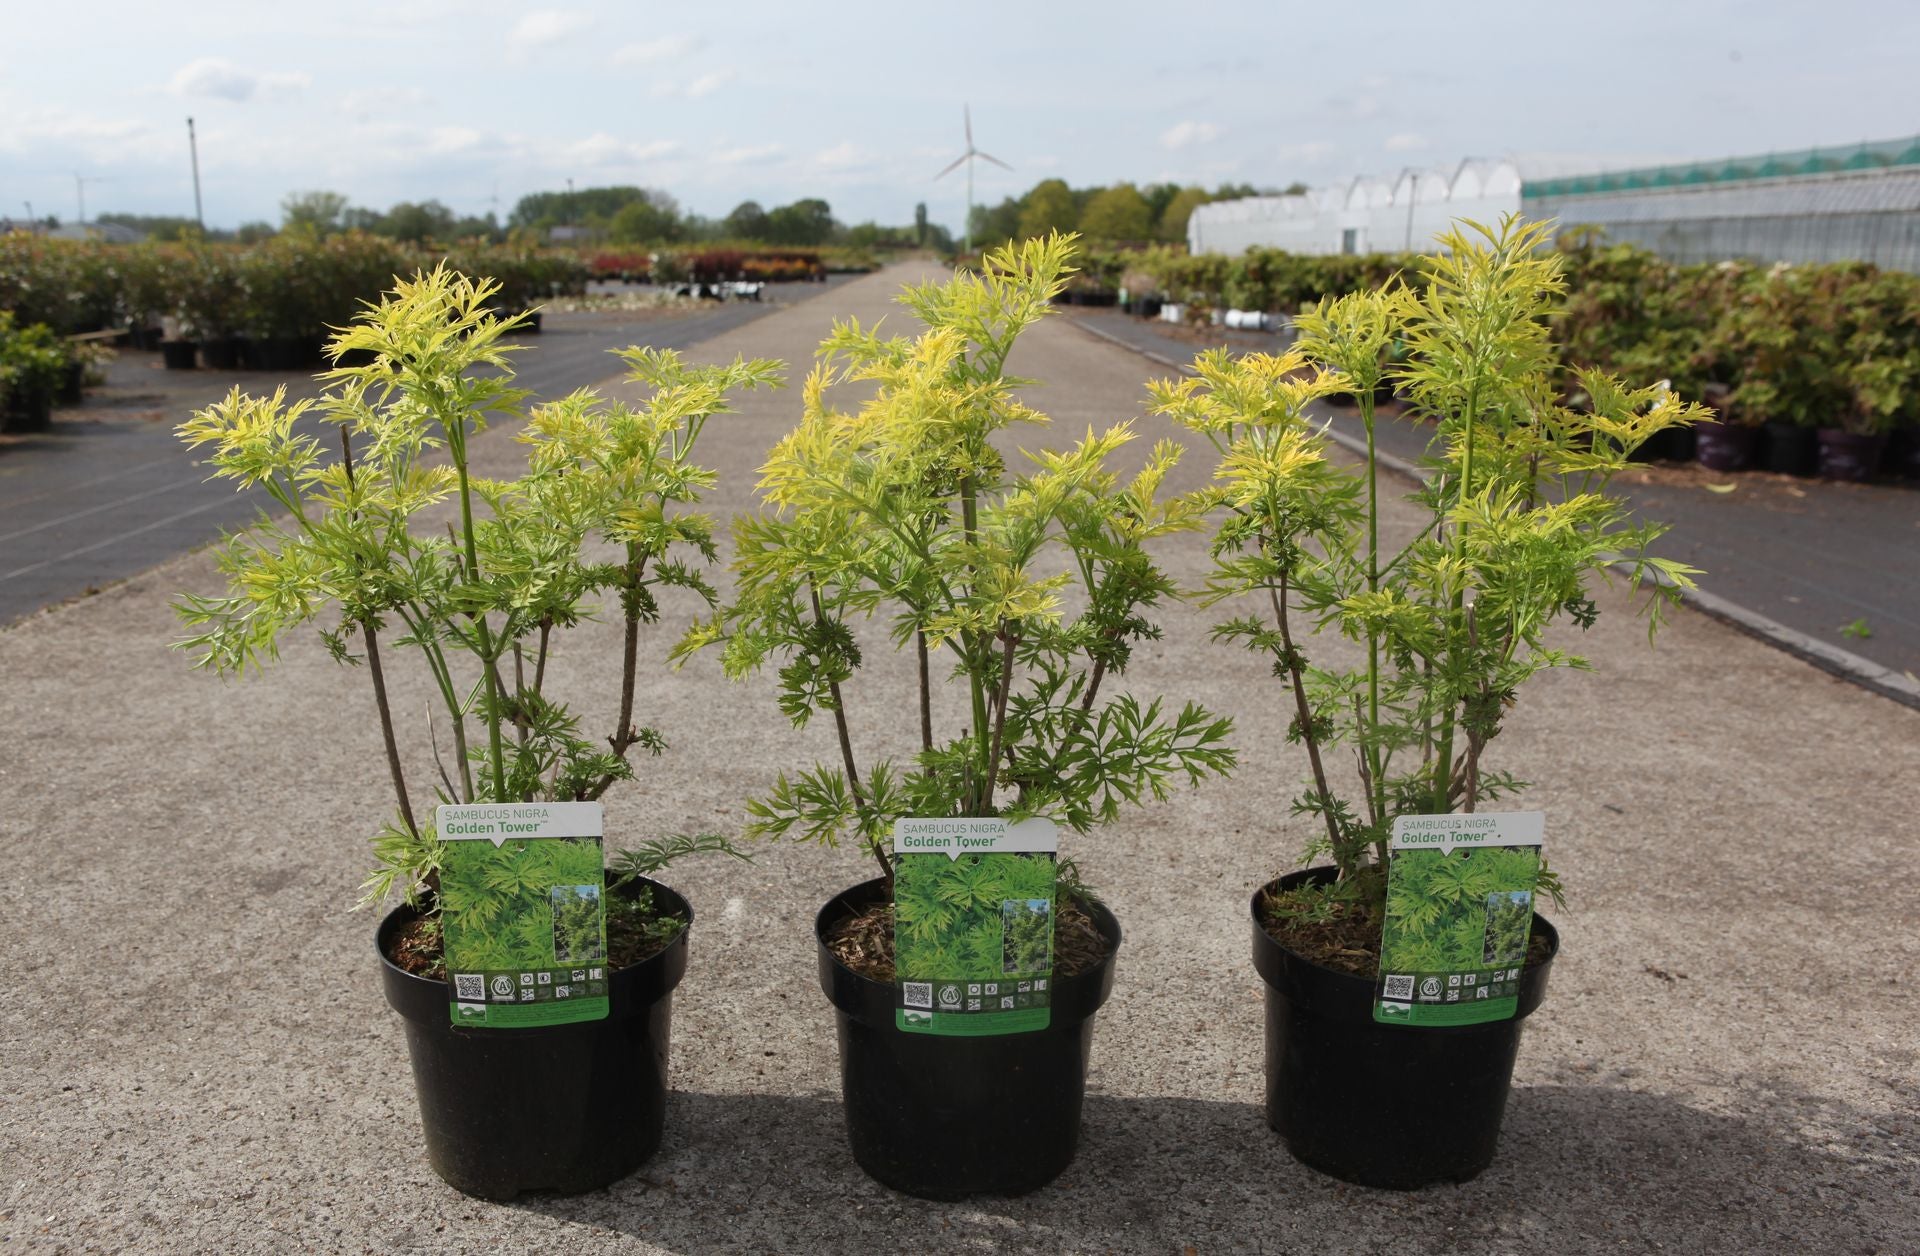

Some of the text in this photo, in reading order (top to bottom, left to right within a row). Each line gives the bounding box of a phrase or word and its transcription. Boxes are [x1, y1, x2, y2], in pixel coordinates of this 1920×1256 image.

[445, 808, 549, 820] SAMBUCUS NIGRA
[446, 821, 541, 834] Golden Tower
[903, 823, 1005, 834] SAMBUCUS NIGRA
[1402, 818, 1497, 831] SAMBUCUS NIGRA
[903, 835, 996, 847] Golden Tower
[1401, 831, 1488, 844] Golden Tower
